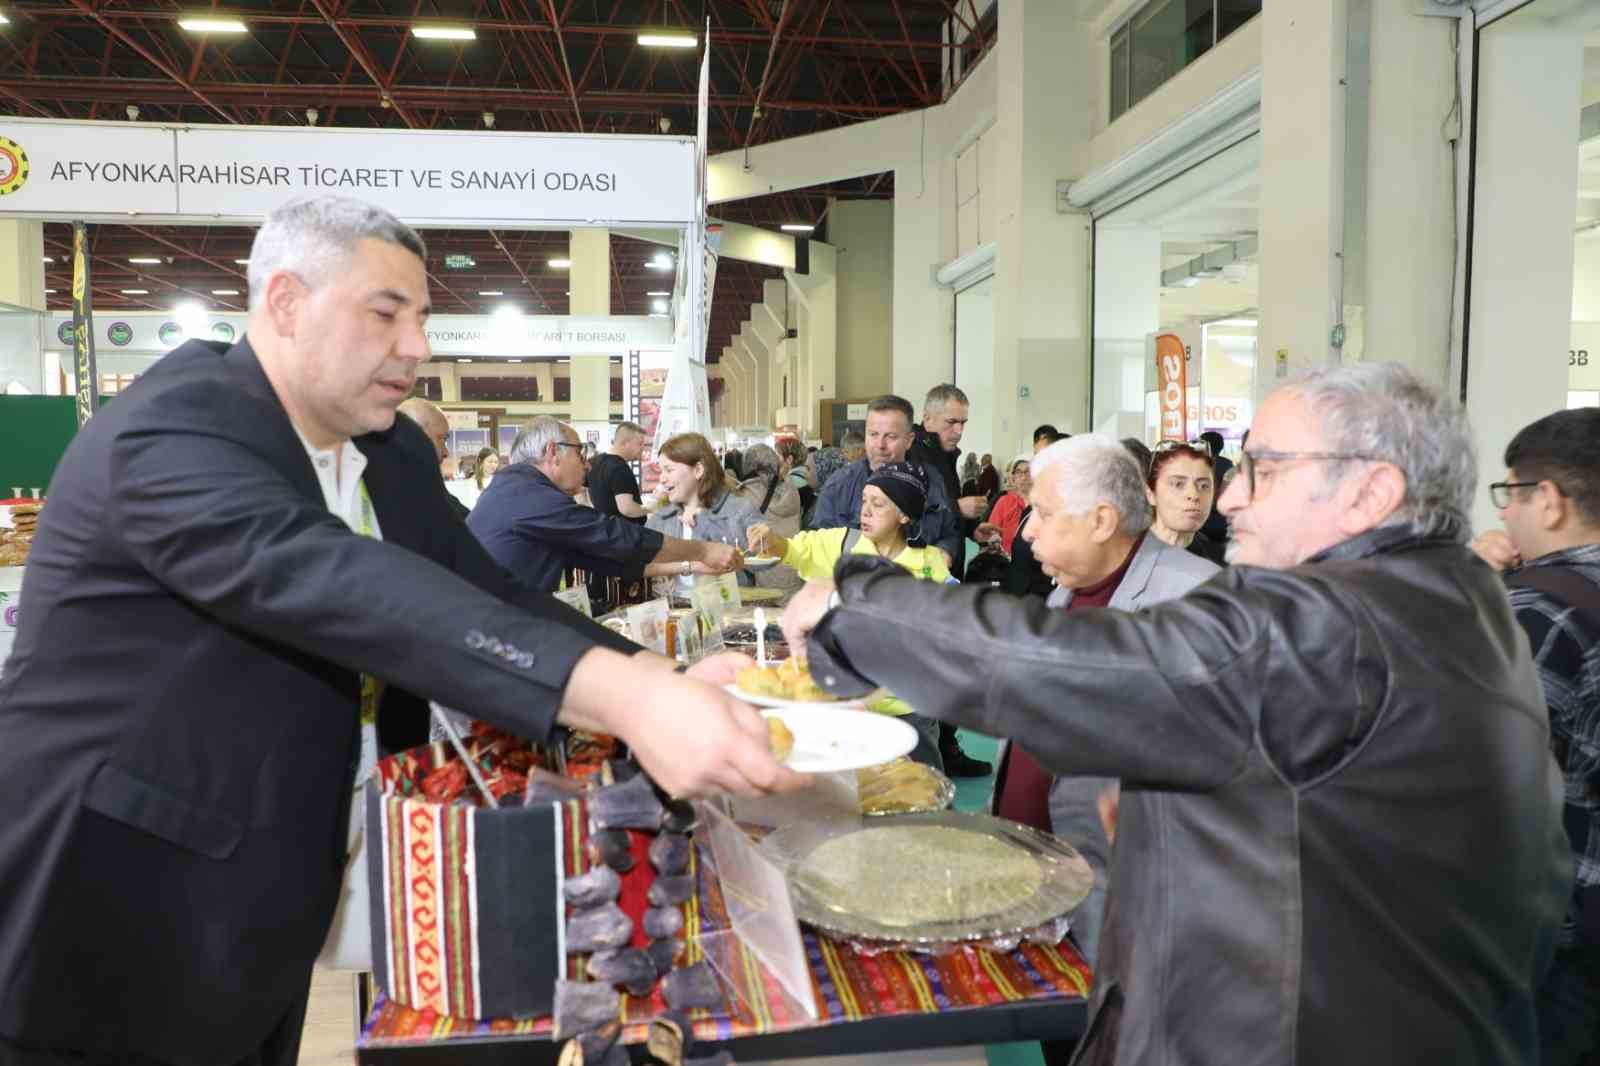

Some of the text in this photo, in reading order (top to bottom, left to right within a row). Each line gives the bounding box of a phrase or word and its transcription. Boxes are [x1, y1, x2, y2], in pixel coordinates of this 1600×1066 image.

[51, 160, 617, 192] AFYONKARAHİSAR TİCARET VE SANAYİ ODASI
[576, 332, 626, 342] BORSASI
[1187, 405, 1237, 421] GROS
